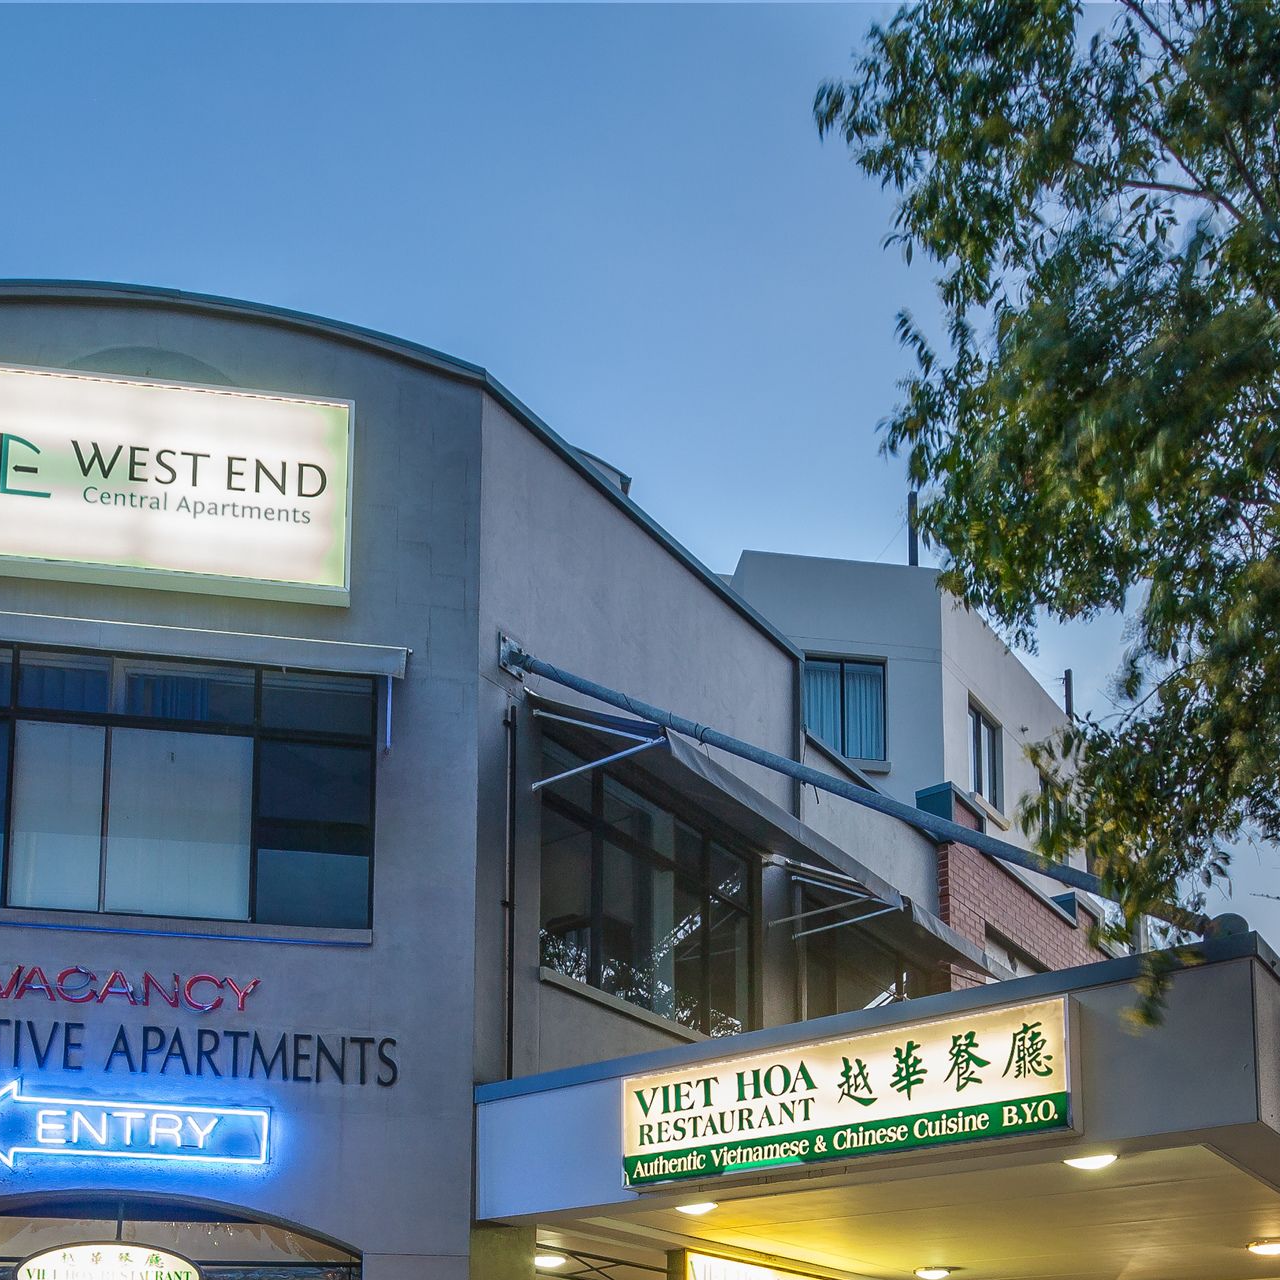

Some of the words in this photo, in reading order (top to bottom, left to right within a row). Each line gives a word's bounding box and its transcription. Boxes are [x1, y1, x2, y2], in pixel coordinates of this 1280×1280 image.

[71, 439, 211, 488] WEST
[226, 455, 328, 499] END
[82, 485, 168, 511] Central
[176, 495, 312, 525] Apartments
[104, 1023, 399, 1088] APARTMENTS
[836, 1021, 1054, 1107] 越華餐廳
[634, 1076, 719, 1119] VIET
[735, 1060, 818, 1103] HOA
[35, 1109, 220, 1149] ENTRY
[633, 1150, 707, 1179] Authentic
[711, 1137, 810, 1167] Vietnamese
[814, 1134, 828, 1153] &
[833, 1124, 909, 1151] Chinese
[913, 1110, 990, 1138] Cuisine
[1001, 1099, 1059, 1128] B.Y.O.
[638, 1097, 816, 1147] RESTAURANT
